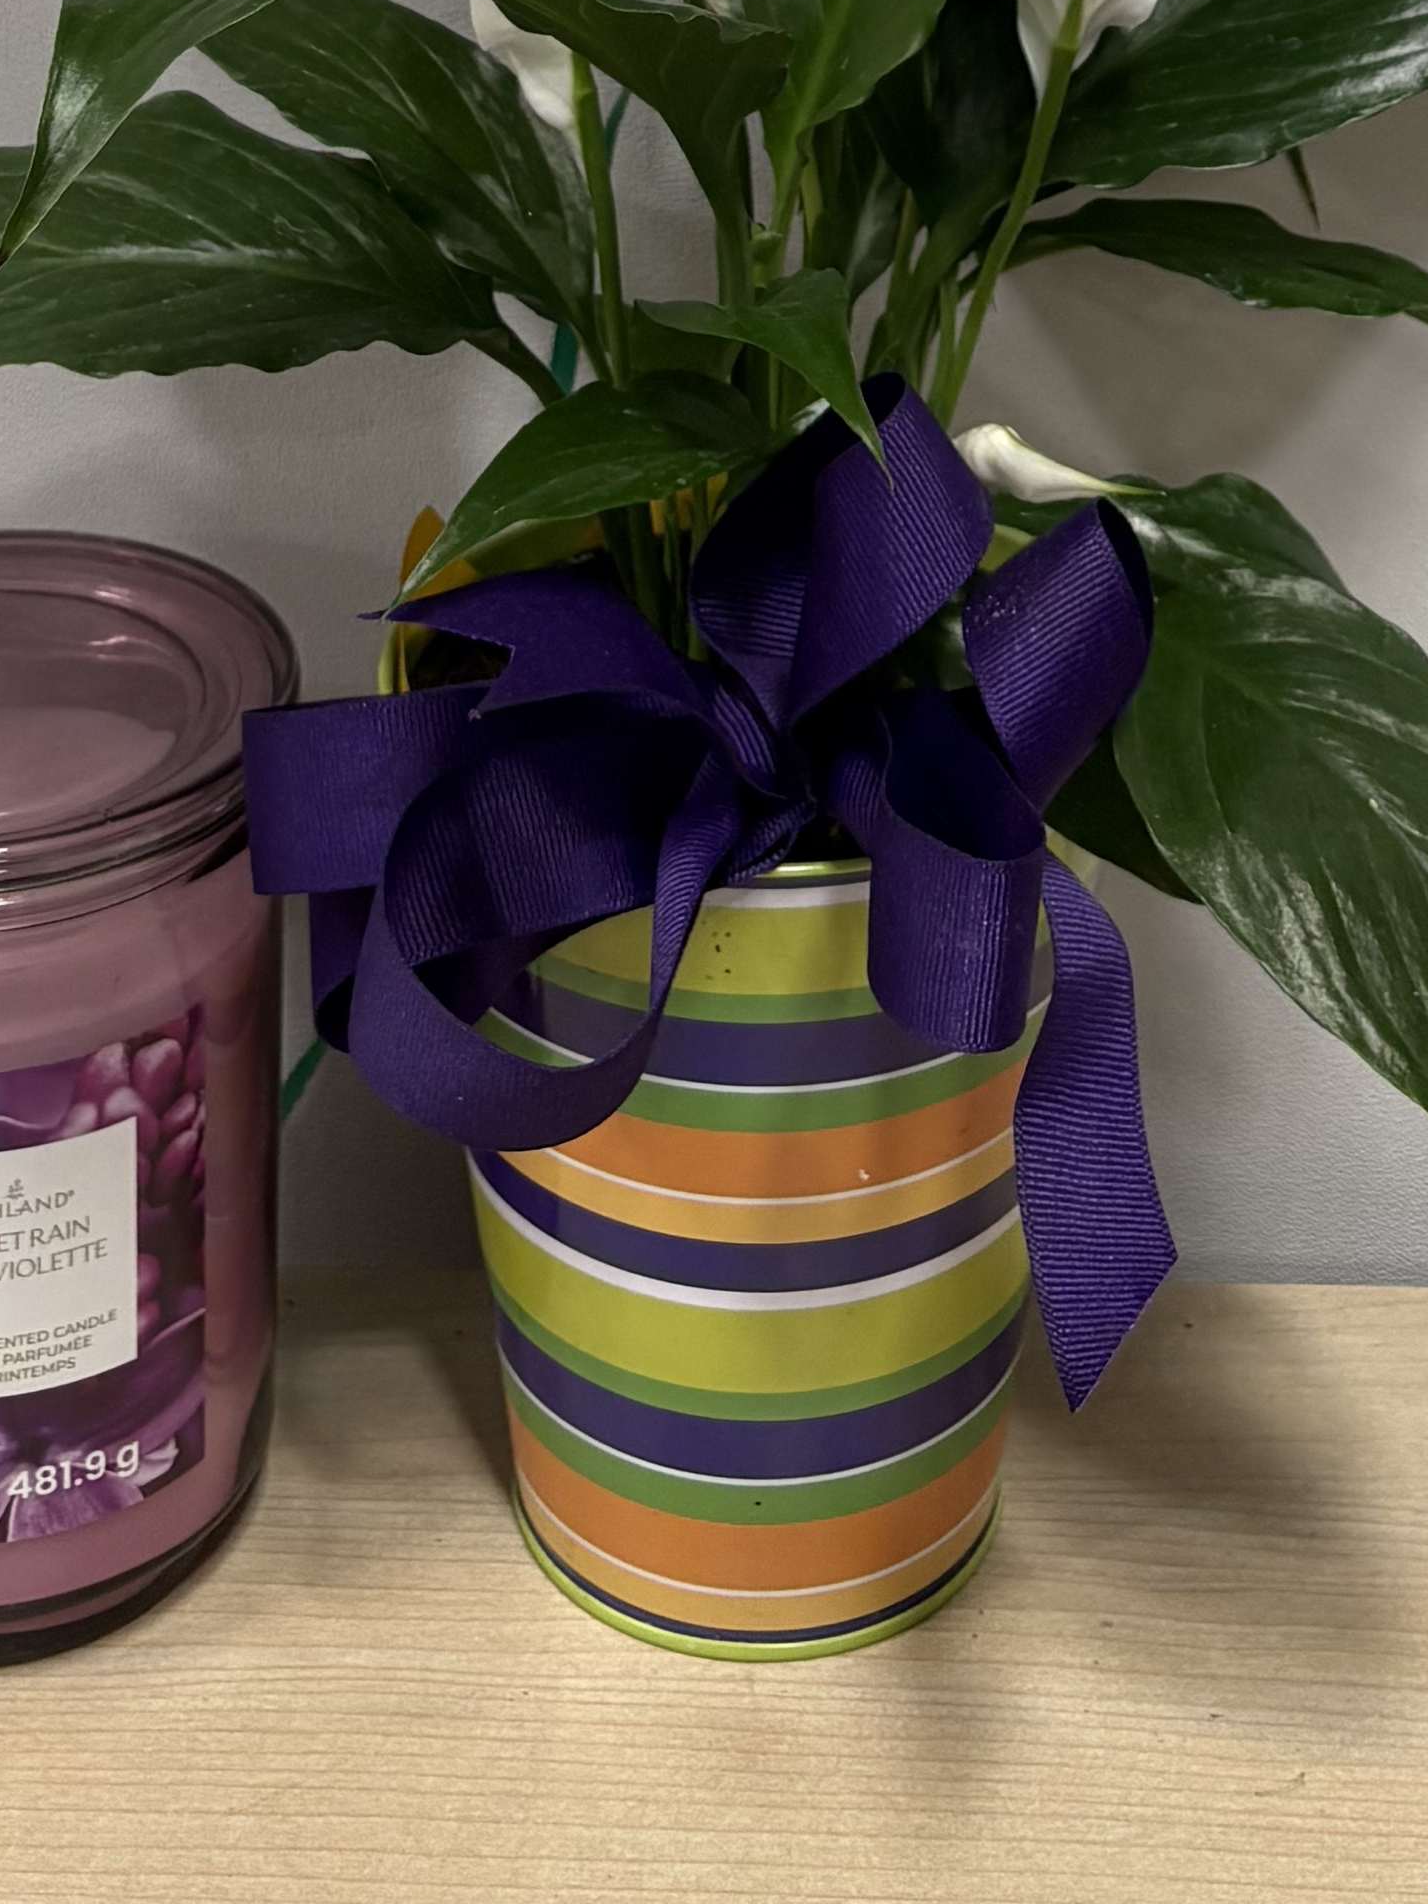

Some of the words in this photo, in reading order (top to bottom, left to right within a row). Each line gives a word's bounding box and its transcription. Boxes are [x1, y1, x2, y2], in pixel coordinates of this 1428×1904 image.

[29, 1216, 92, 1248] RAIN
[53, 1308, 118, 1338] CANDLE
[2, 1334, 93, 1366] PARFUMÉE
[6, 1451, 108, 1501] 481.9
[117, 1440, 142, 1476] g
